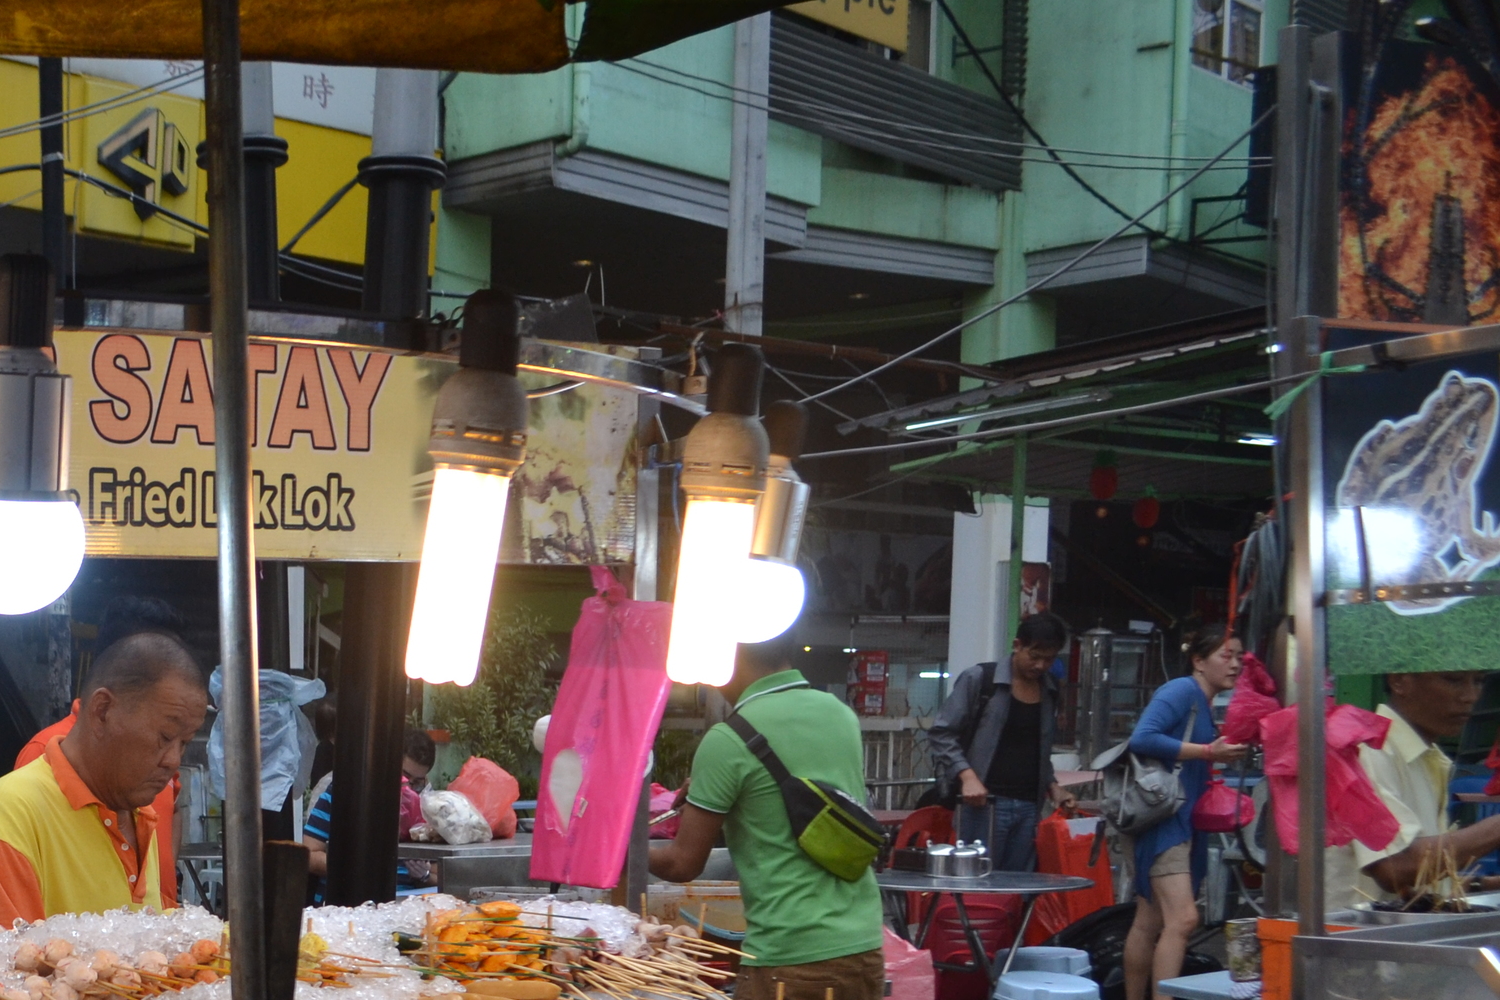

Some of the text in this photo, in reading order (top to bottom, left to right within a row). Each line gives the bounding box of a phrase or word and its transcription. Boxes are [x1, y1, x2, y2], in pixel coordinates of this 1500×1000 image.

[303, 72, 335, 109] 時
[89, 466, 196, 528] Fried
[202, 470, 278, 529] Lk
[281, 472, 355, 531] Lok
